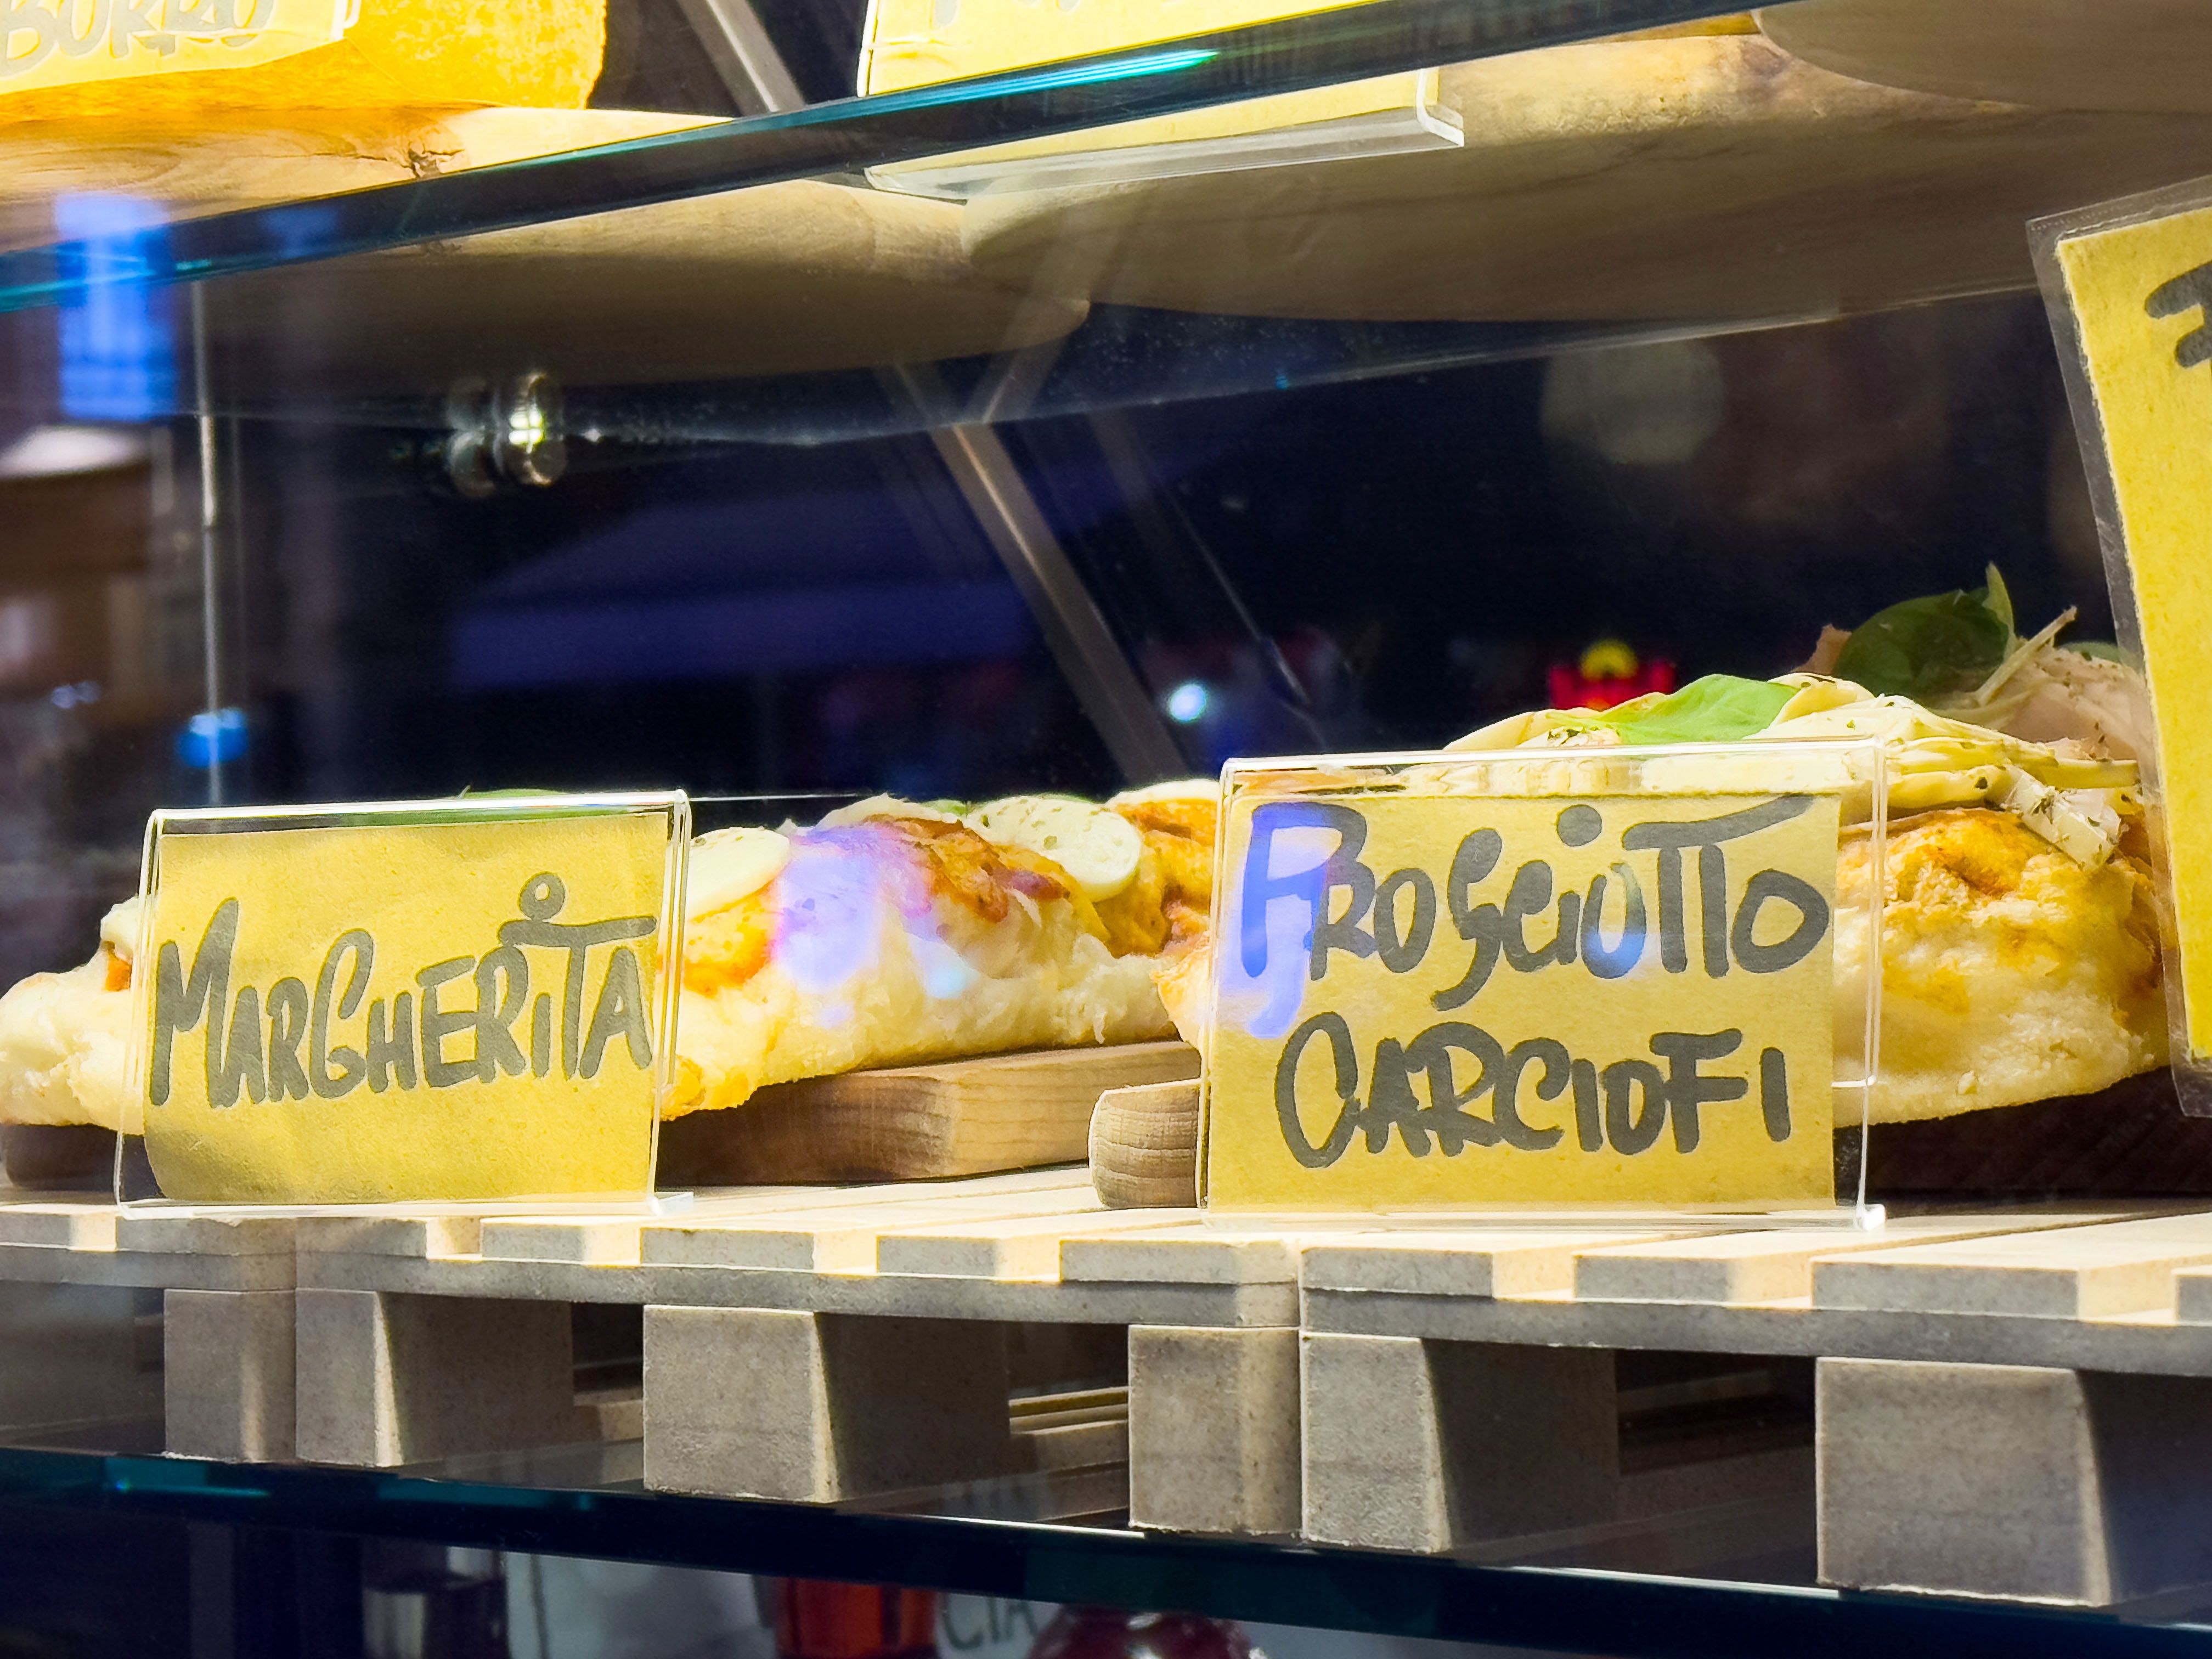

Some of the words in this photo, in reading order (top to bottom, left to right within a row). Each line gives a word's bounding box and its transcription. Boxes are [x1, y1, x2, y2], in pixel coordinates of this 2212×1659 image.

[150, 871, 658, 1108] MARGHERITA
[1241, 793, 1831, 1012] PROSCIUTTO
[1274, 1011, 1792, 1169] CARCIOFI
